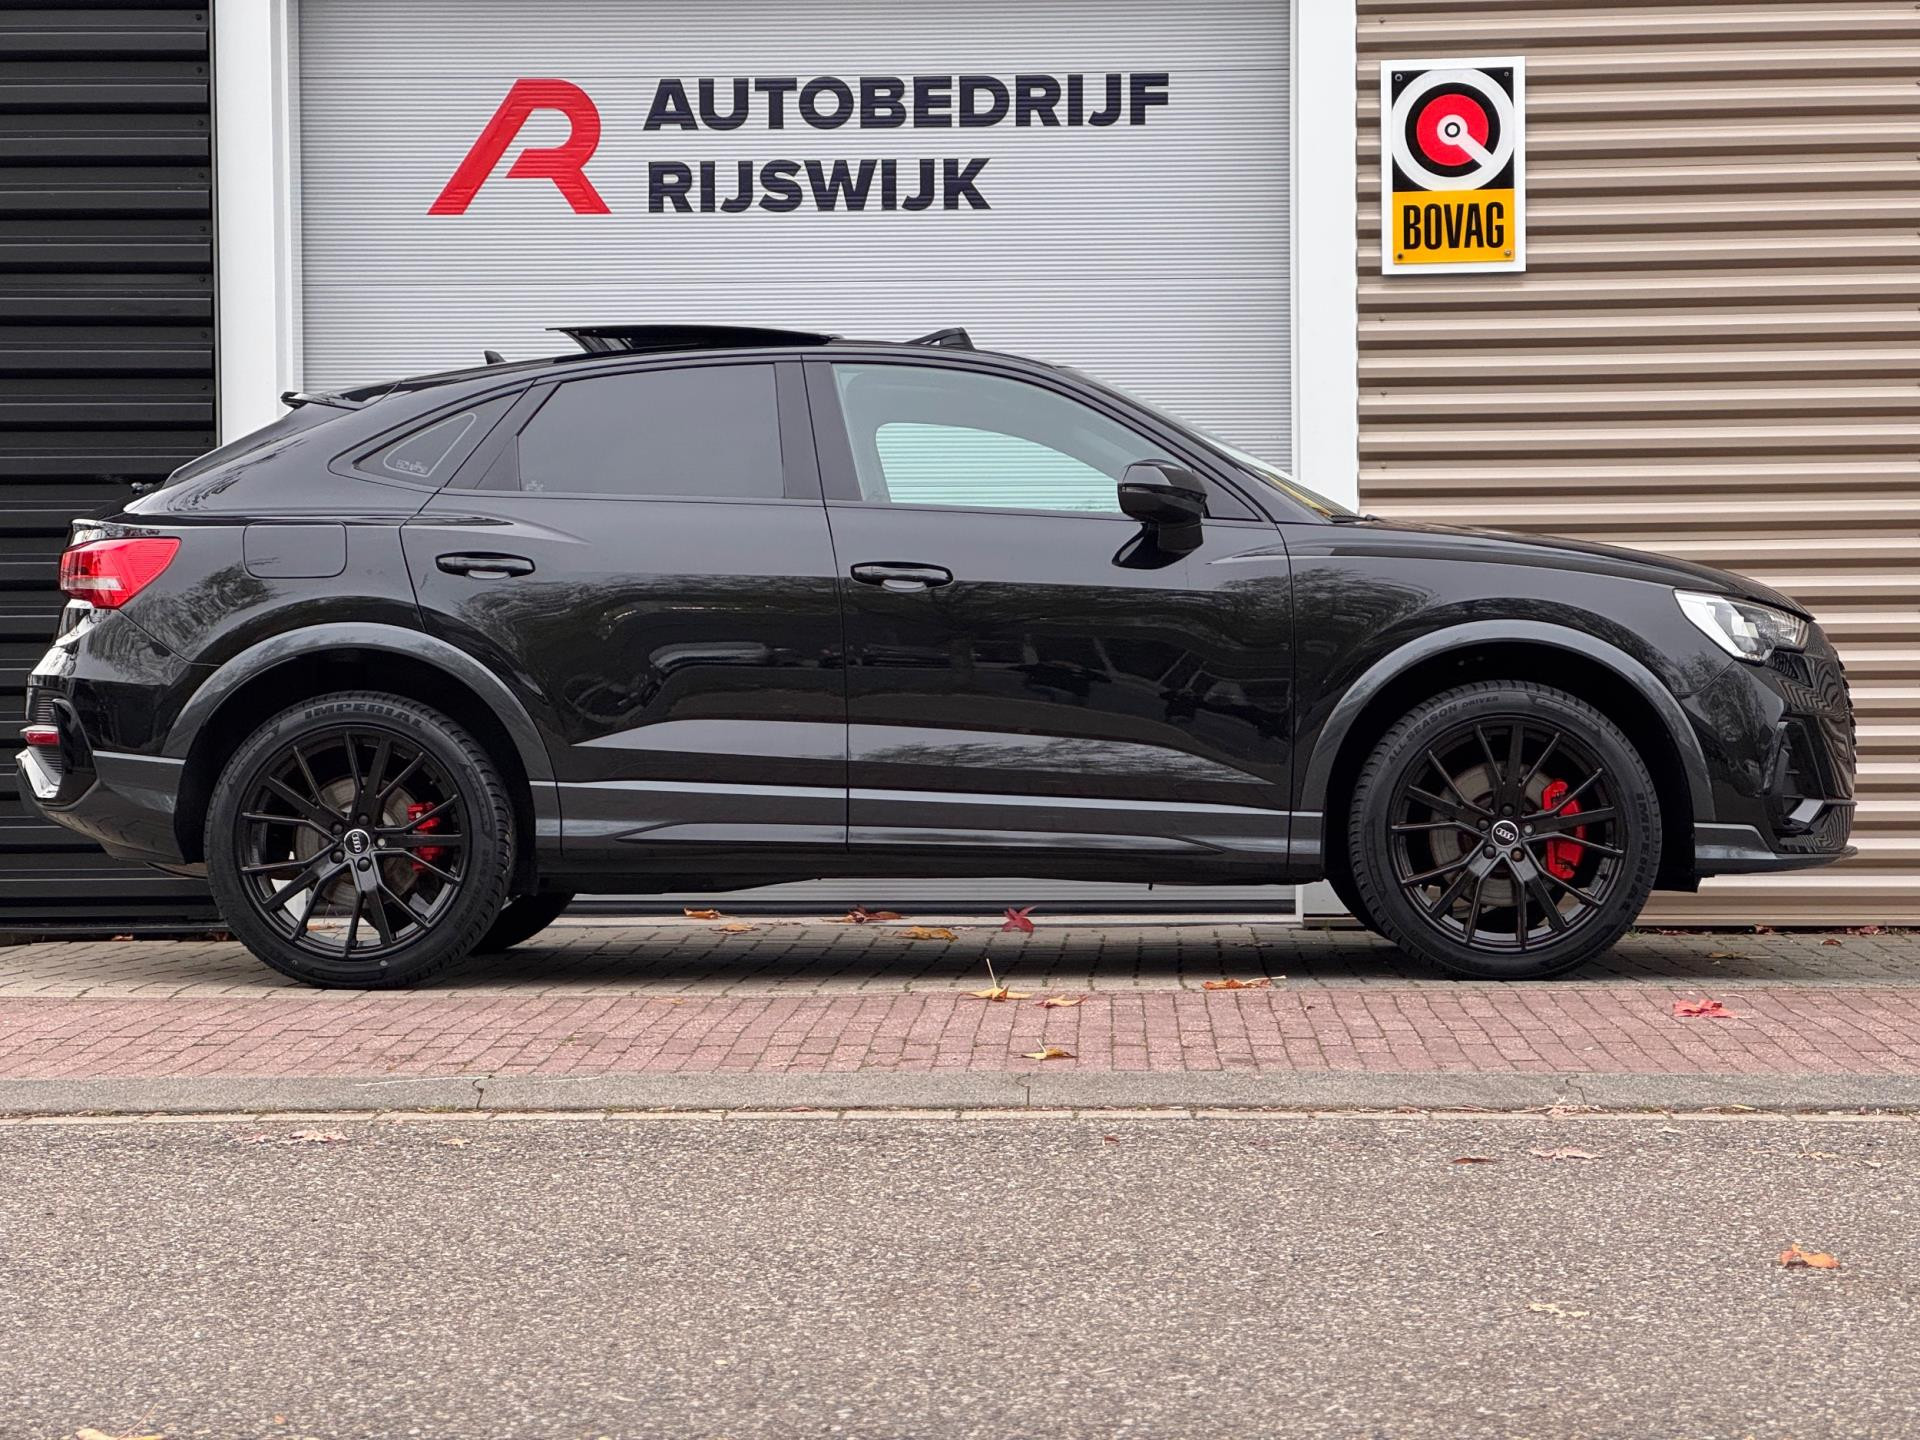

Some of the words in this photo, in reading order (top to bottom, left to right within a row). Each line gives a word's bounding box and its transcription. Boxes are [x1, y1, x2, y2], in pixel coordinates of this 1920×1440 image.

[643, 73, 1169, 131] AUTOBEDRIJF
[649, 158, 991, 213] RIJSWIJK
[1403, 201, 1504, 250] BOVAG
[305, 703, 422, 729] IMPERIAL
[1406, 704, 1458, 741] SEASON
